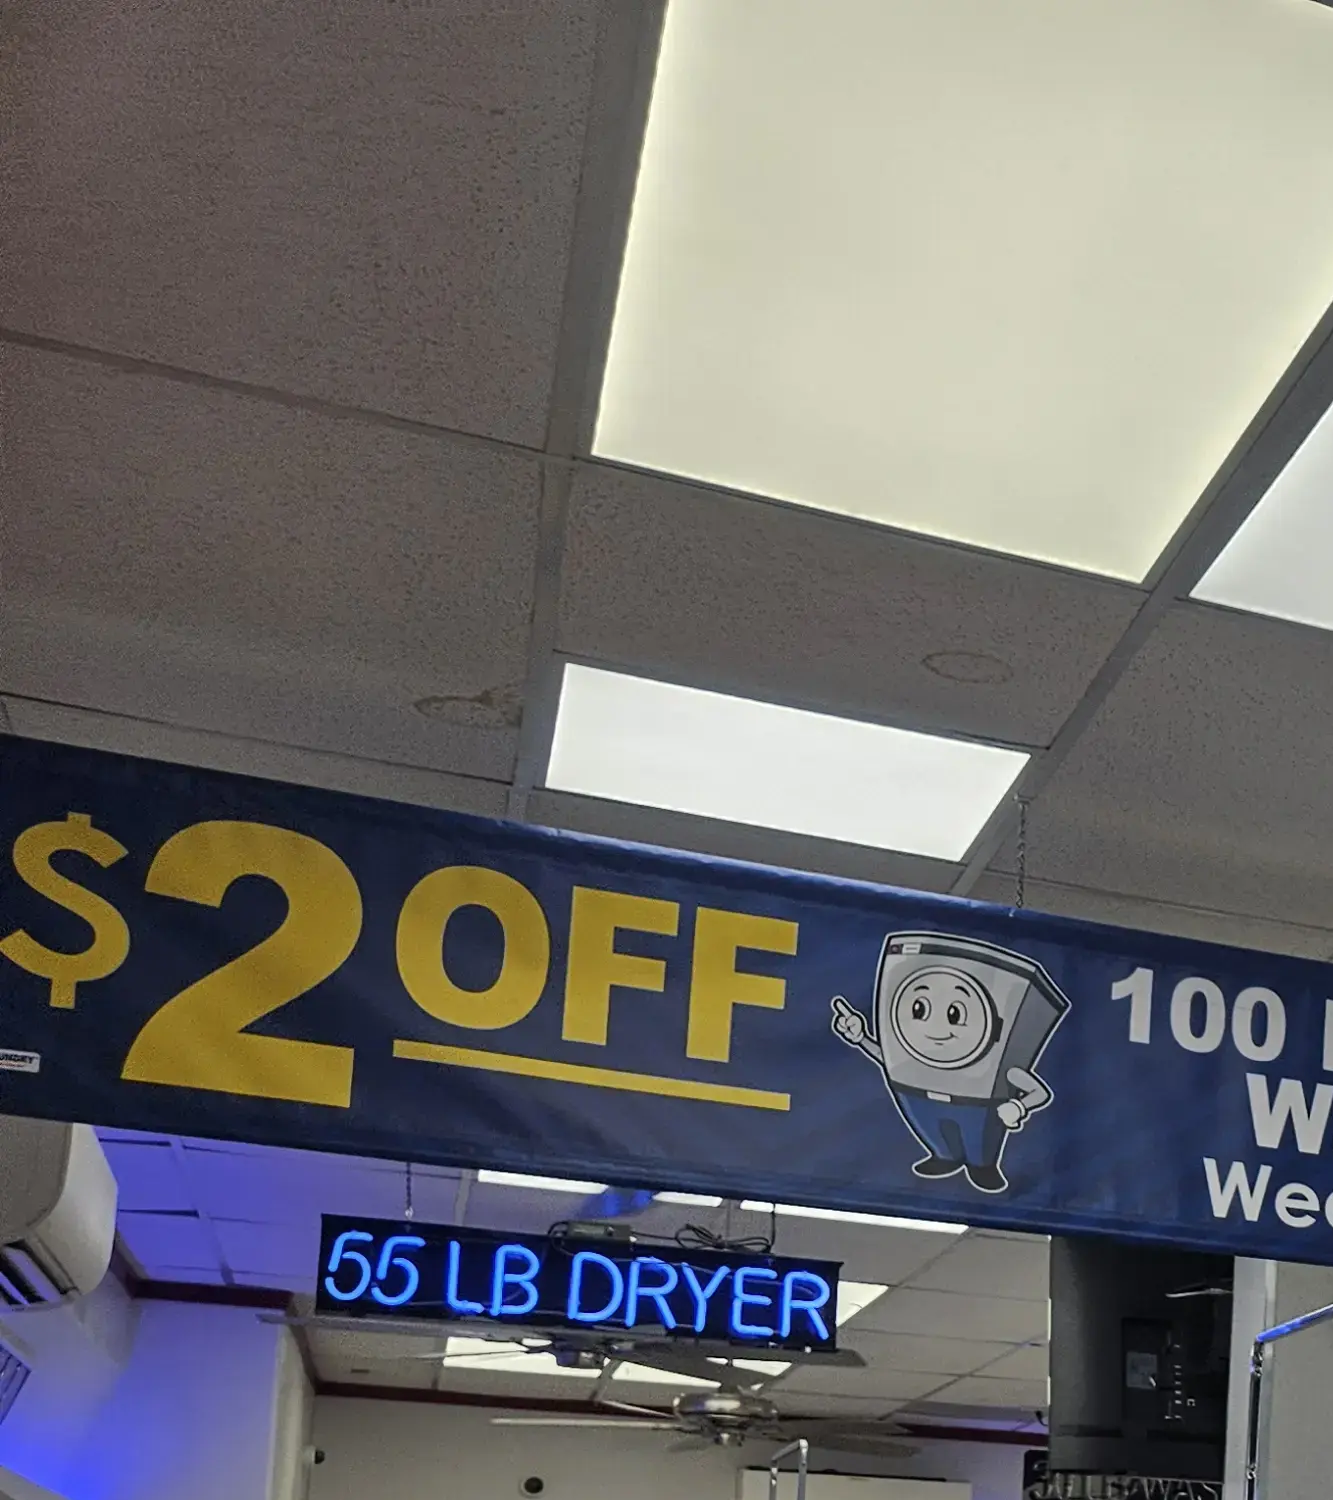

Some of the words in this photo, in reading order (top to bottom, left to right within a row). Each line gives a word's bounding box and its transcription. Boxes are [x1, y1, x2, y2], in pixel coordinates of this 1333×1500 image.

[0, 812, 364, 1108] $2
[395, 865, 799, 1063] OFF
[1110, 968, 1285, 1062] 100
[326, 1231, 426, 1306] 55
[446, 1241, 541, 1316] LB
[567, 1250, 832, 1341] DRYER
